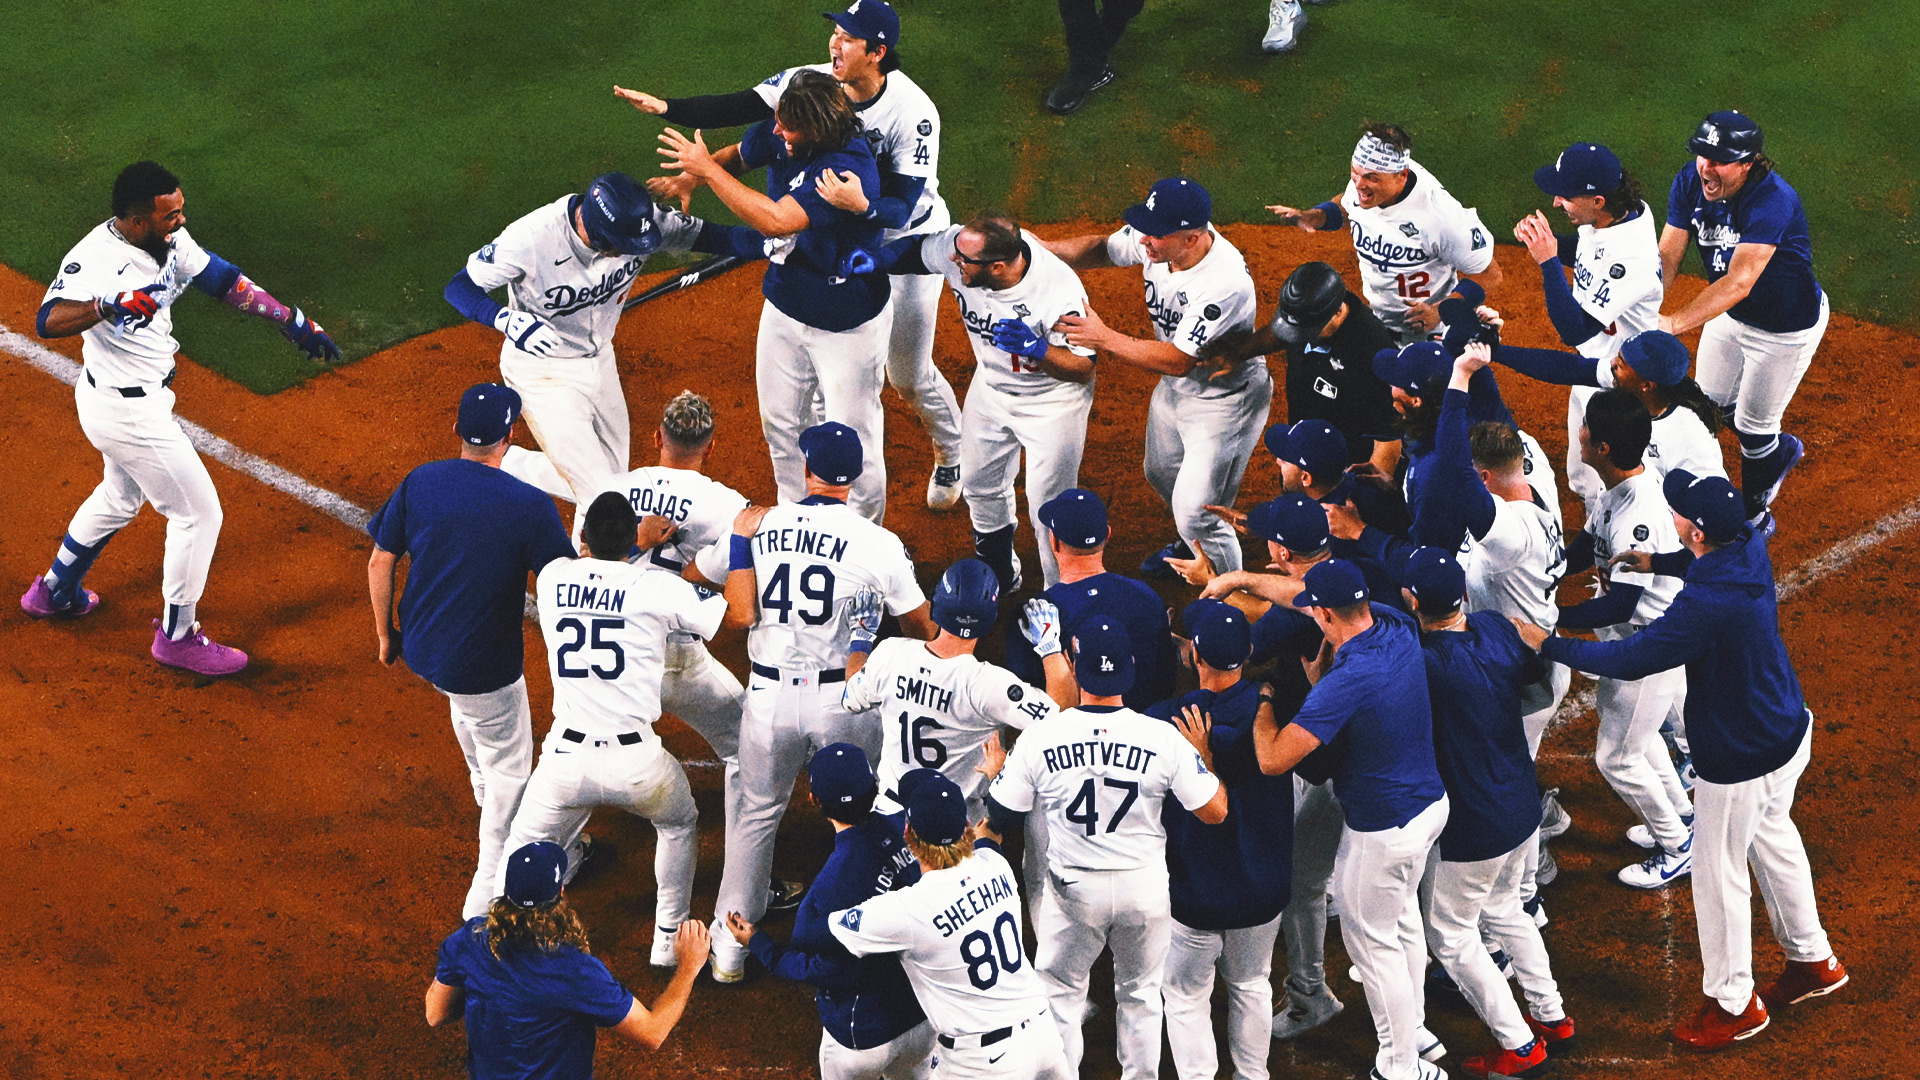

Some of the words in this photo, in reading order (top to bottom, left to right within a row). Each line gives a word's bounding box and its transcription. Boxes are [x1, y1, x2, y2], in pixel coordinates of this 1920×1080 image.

[913, 138, 930, 165] LA
[595, 196, 615, 223] STRAUSS
[640, 217, 651, 233] LA
[1350, 219, 1429, 272] Dodgers
[1712, 249, 1726, 271] LA
[544, 257, 642, 309] Dodgers
[1393, 271, 1431, 298] 12
[1591, 278, 1611, 309] LA
[1188, 316, 1208, 347] LA
[629, 487, 693, 523] ROJAS
[754, 528, 848, 563] TREINEN
[556, 583, 626, 613] EDMAN
[761, 563, 836, 626] 49
[555, 617, 626, 680] 25
[959, 628, 971, 638] 16
[1101, 655, 1114, 671] LA
[896, 676, 953, 714] SMITH
[1017, 702, 1048, 720] LA
[898, 711, 948, 769] 16
[1043, 740, 1157, 775] RORTVEDT
[1065, 778, 1139, 836] 47
[932, 873, 1014, 938] SHEEHAN
[960, 911, 1022, 991] 80
